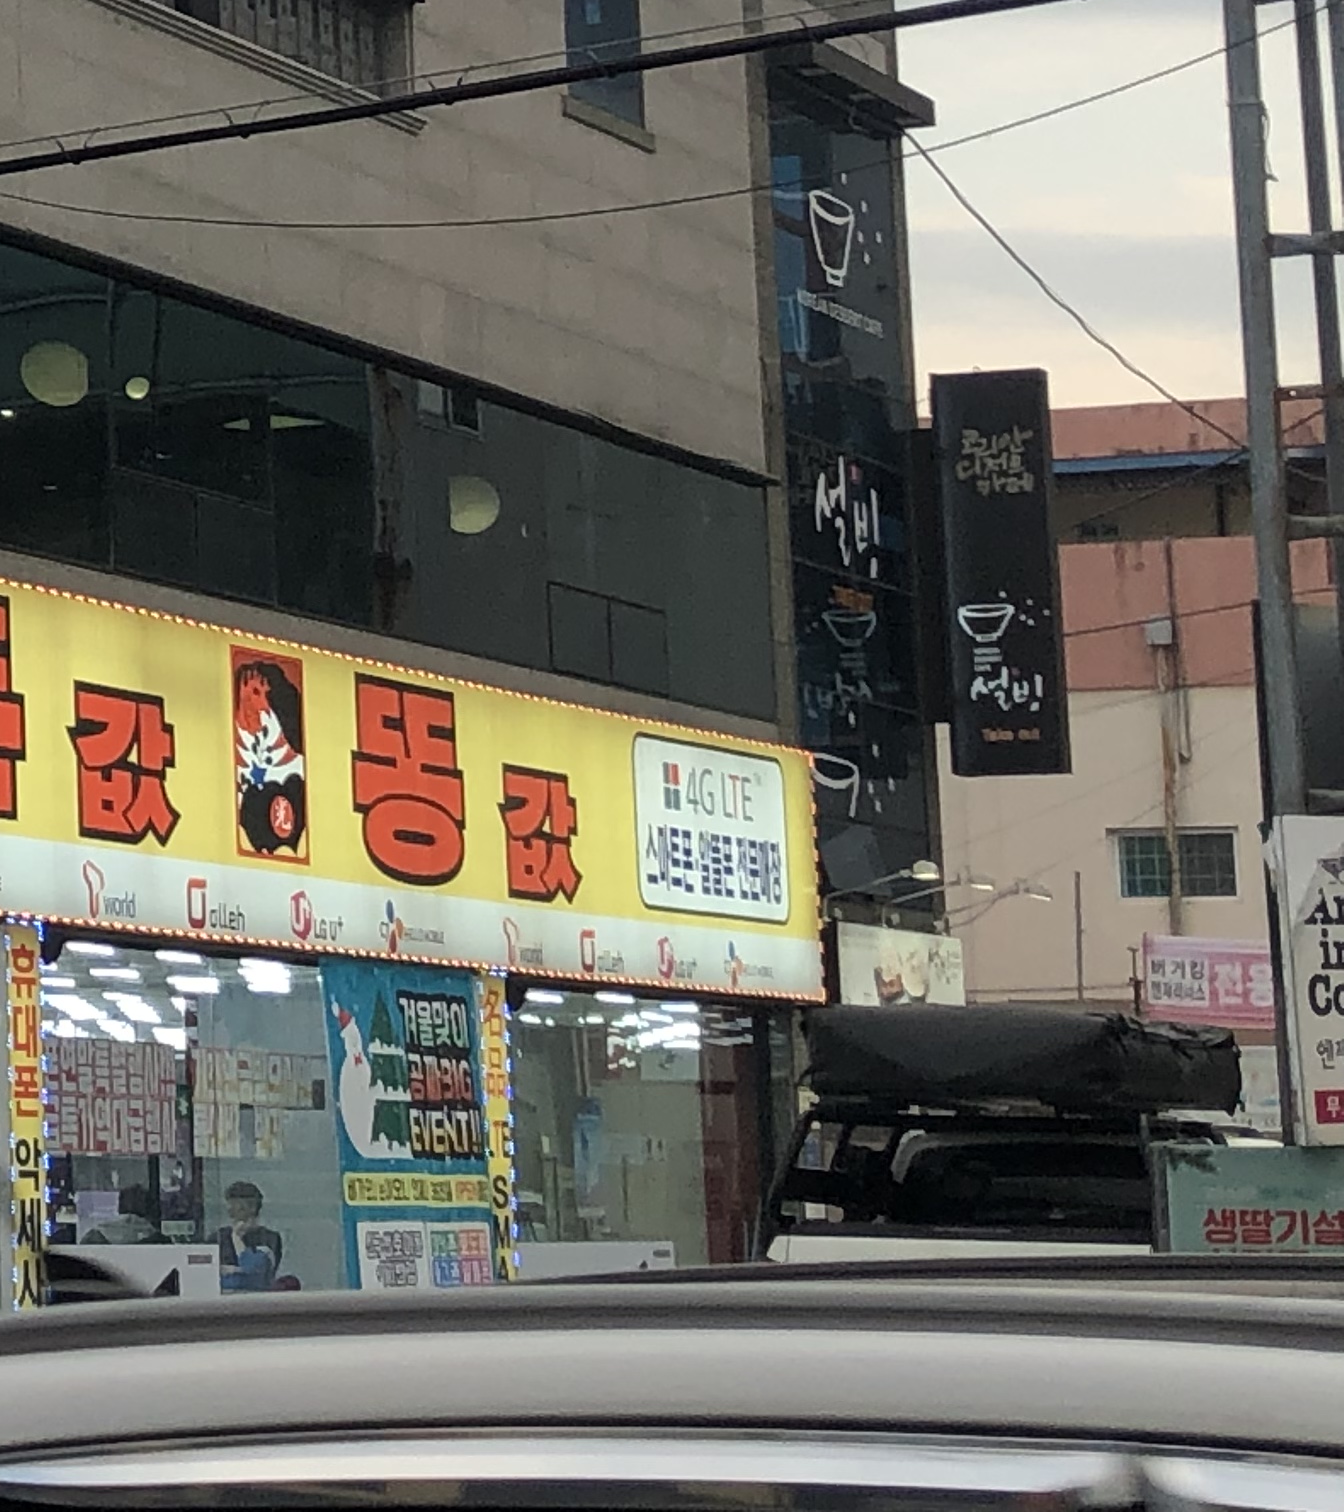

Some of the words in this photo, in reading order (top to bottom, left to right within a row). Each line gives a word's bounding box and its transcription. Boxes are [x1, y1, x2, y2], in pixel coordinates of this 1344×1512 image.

[815, 455, 879, 579] 설빙
[971, 665, 1043, 712] 설빙
[686, 767, 715, 816] 4G
[721, 771, 754, 822] LTE
[1151, 959, 1205, 980] 버거킹
[10, 944, 40, 1118] 휴대폰
[399, 997, 470, 1049] 겨울맞이
[410, 1105, 482, 1155] EVENT!!
